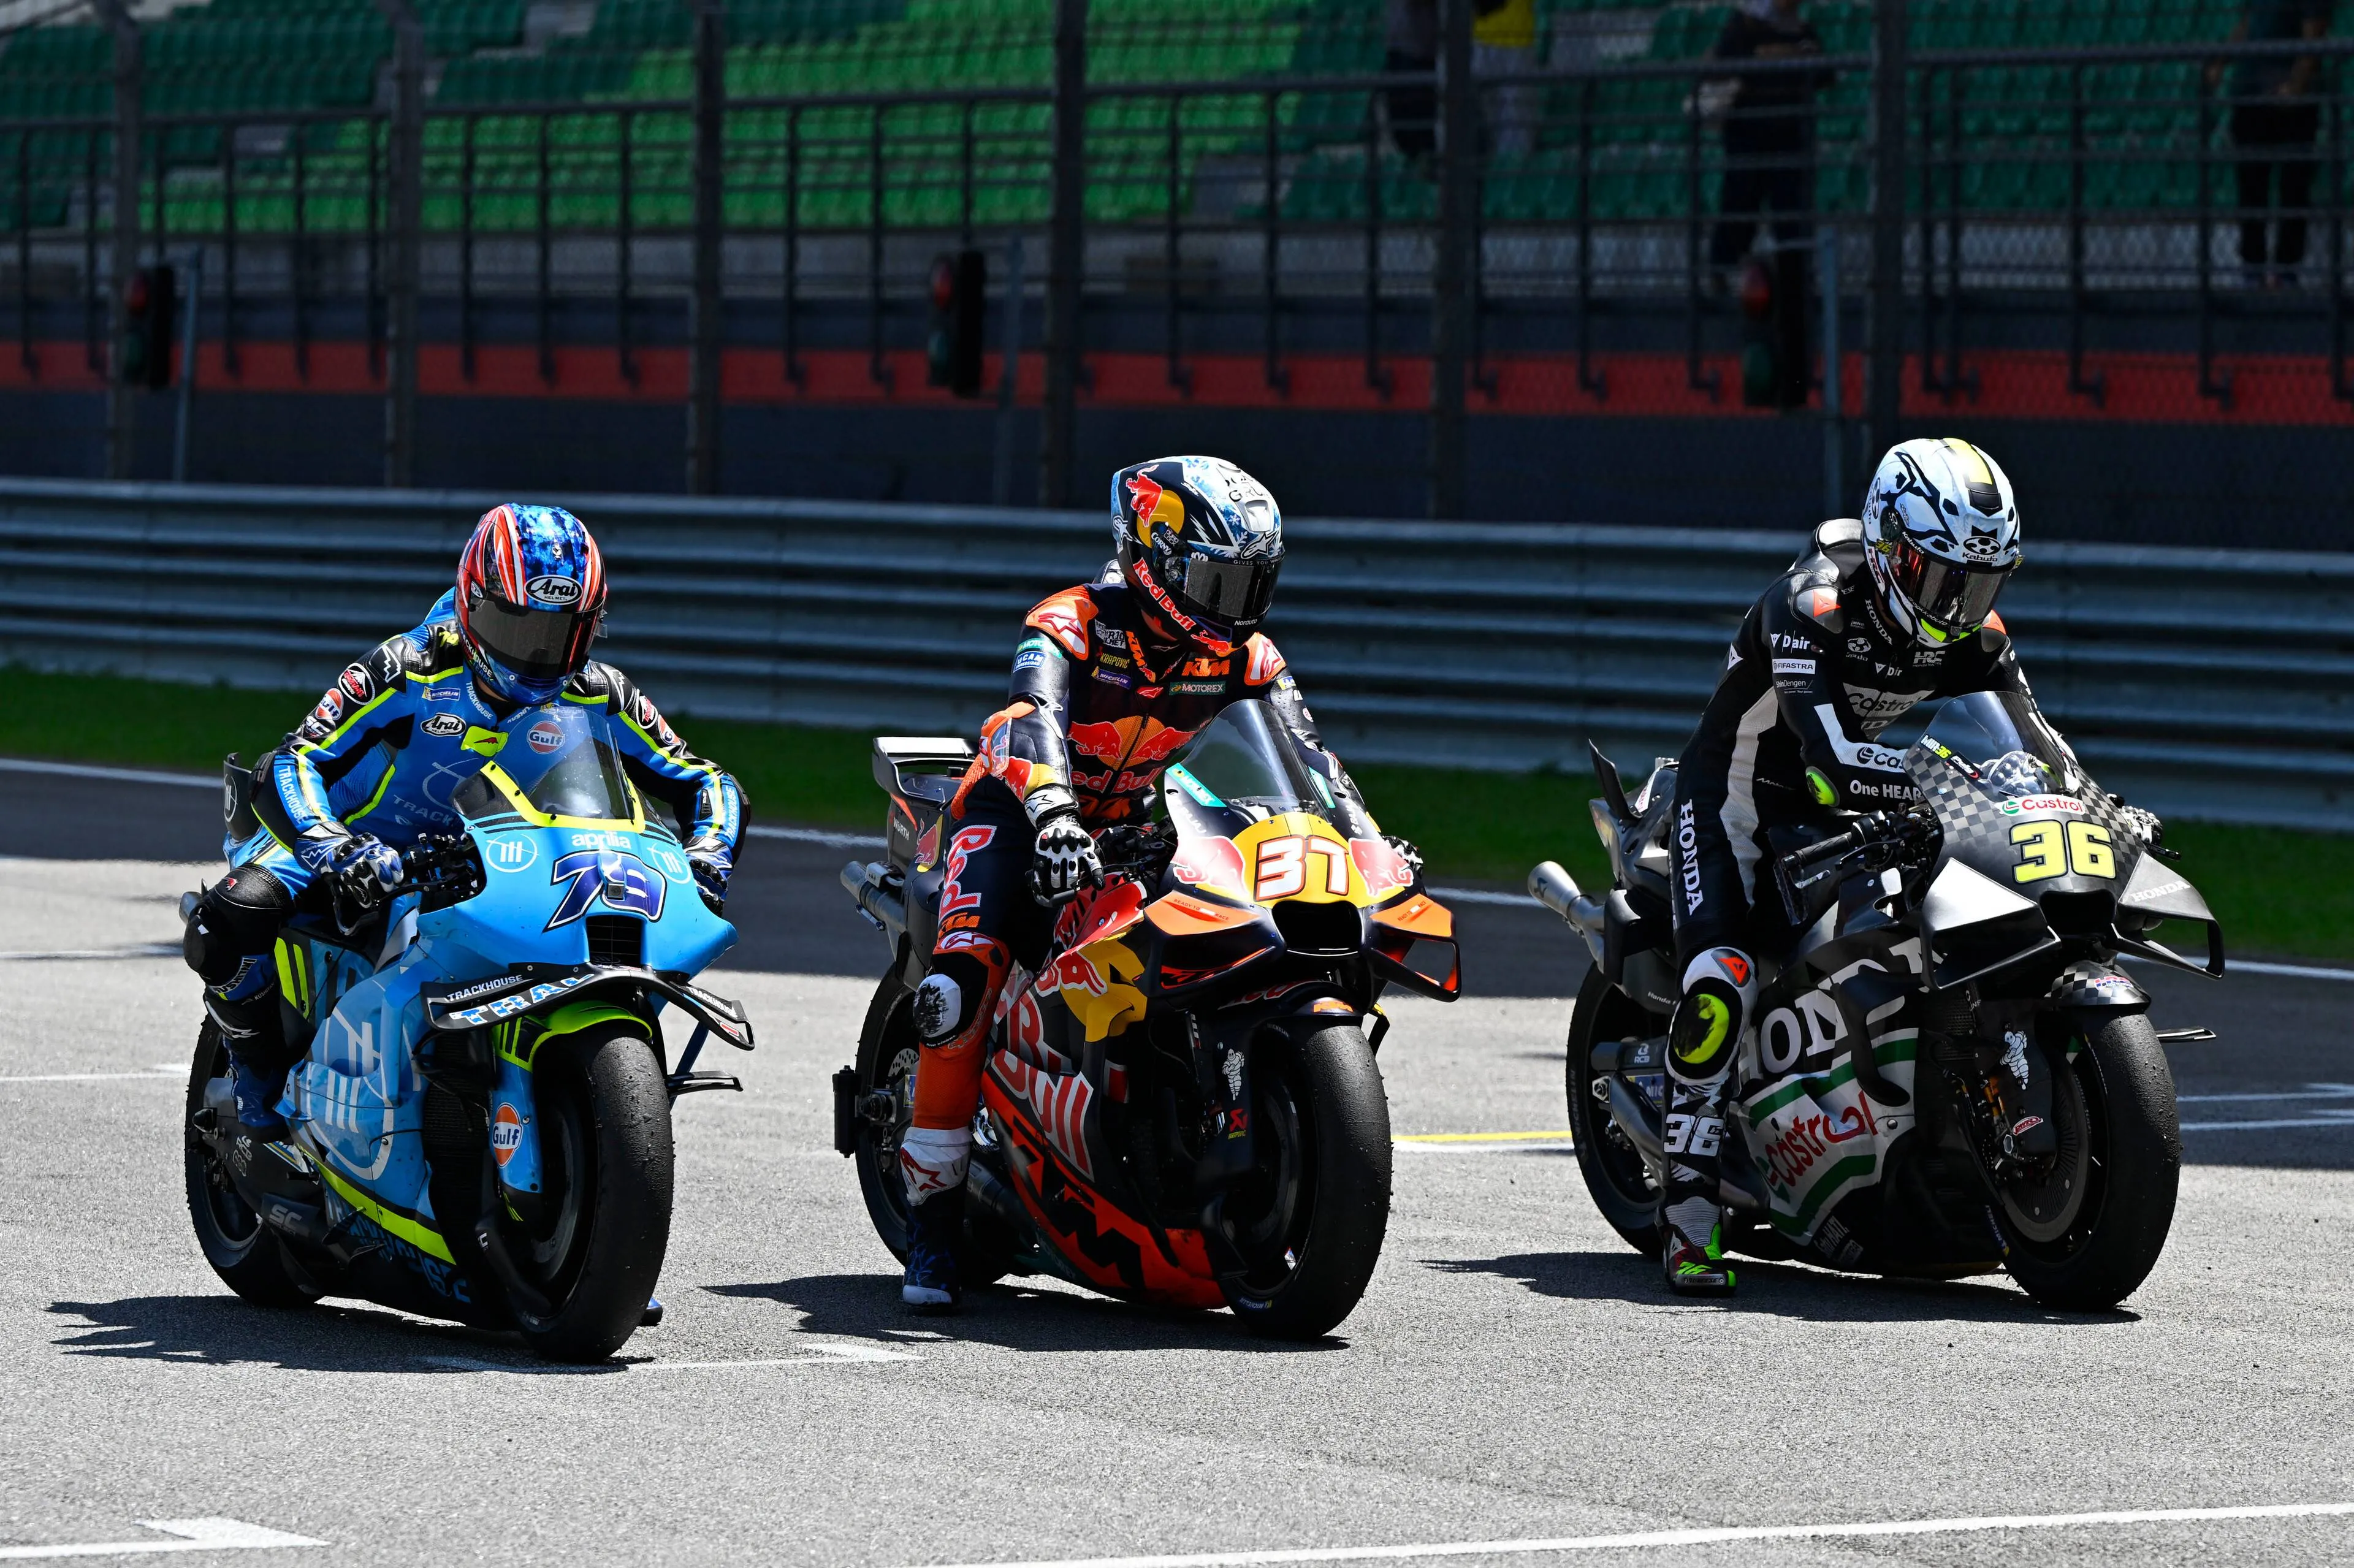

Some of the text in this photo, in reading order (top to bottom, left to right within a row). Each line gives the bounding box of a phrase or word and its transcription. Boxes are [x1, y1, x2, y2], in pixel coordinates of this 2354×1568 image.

[1902, 531, 1925, 555] Kabuto
[1962, 552, 1998, 562] Kabuto
[530, 580, 577, 595] Arai
[1132, 557, 1197, 631] Red Bull
[1865, 598, 1894, 646] HONDA
[1126, 630, 1146, 667] KTM
[1912, 650, 1946, 664] HRC
[1181, 657, 1230, 677] KTM
[1099, 673, 1129, 684] MICHELIN
[1181, 683, 1224, 693] MOTOREX
[1776, 679, 1806, 688] ShinDengen
[466, 681, 493, 720] TRACKHOUSE
[424, 715, 462, 731] Arai
[529, 731, 563, 745] Gulf
[1071, 769, 1114, 794] ed
[1850, 779, 1879, 797] One
[278, 766, 307, 824] TRACKHOUSE
[2021, 797, 2083, 813] Castrol
[893, 817, 910, 840] WÜRTH
[571, 832, 631, 850] aprilia
[2009, 820, 2117, 883] 36
[1253, 834, 1349, 902] 37
[1678, 799, 1704, 916] HONDA
[2133, 880, 2192, 902] HONDA
[1173, 898, 1192, 909] READY
[1214, 912, 1230, 921] RACE
[448, 974, 523, 1002] TRACKHOUSE
[1647, 991, 1672, 1005] Honda
[687, 986, 739, 1019] TRACKHOUSE
[1313, 1002, 1354, 1013] KTM
[492, 1125, 520, 1146] Gulf
[1663, 1113, 1725, 1157] 36
